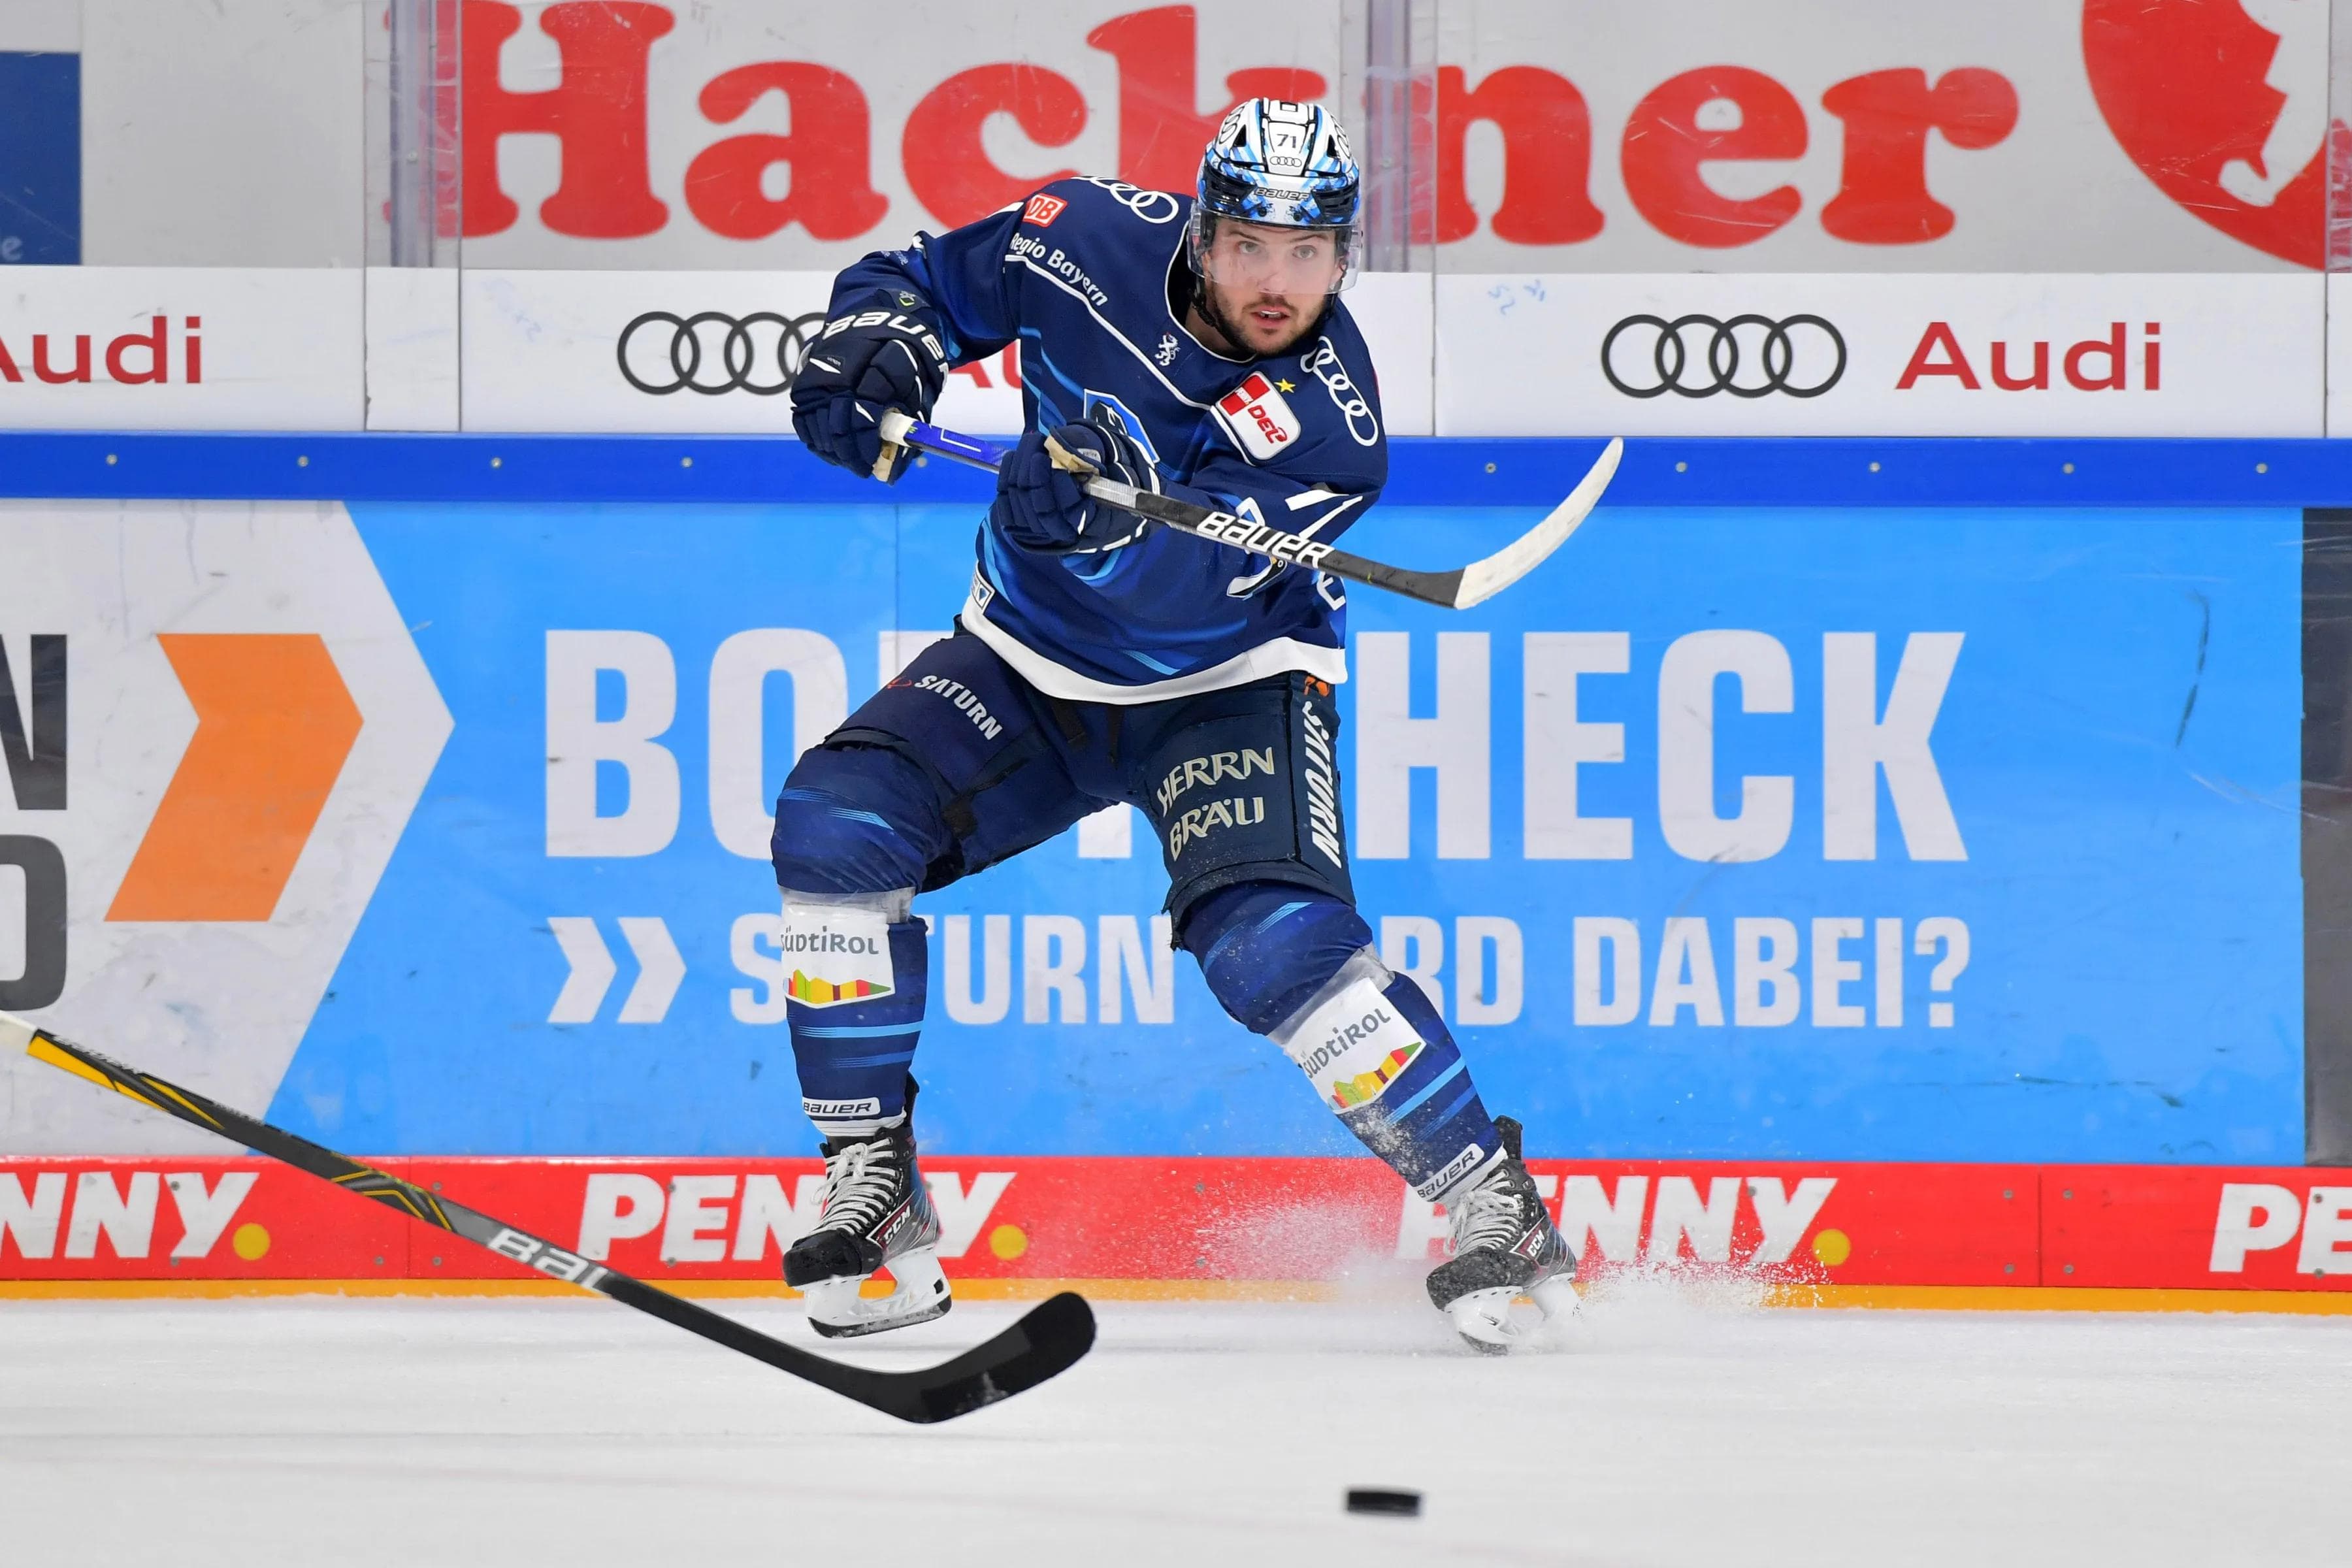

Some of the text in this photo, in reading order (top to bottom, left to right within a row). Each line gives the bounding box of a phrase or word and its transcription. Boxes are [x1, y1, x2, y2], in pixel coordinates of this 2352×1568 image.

[1276, 133, 1298, 149] 71
[1026, 196, 1059, 221] DB
[1010, 232, 1109, 306] Regio Bayern
[1896, 322, 2162, 391] Audi
[1248, 404, 1288, 444] DEL
[914, 675, 1004, 741] SATURN
[1156, 746, 1275, 817] HERRN
[1169, 796, 1265, 862] BRÄU
[730, 913, 1971, 1028] SURN RD DABEI?
[883, 1204, 911, 1245] CCM
[1526, 1229, 1546, 1258] CCM
